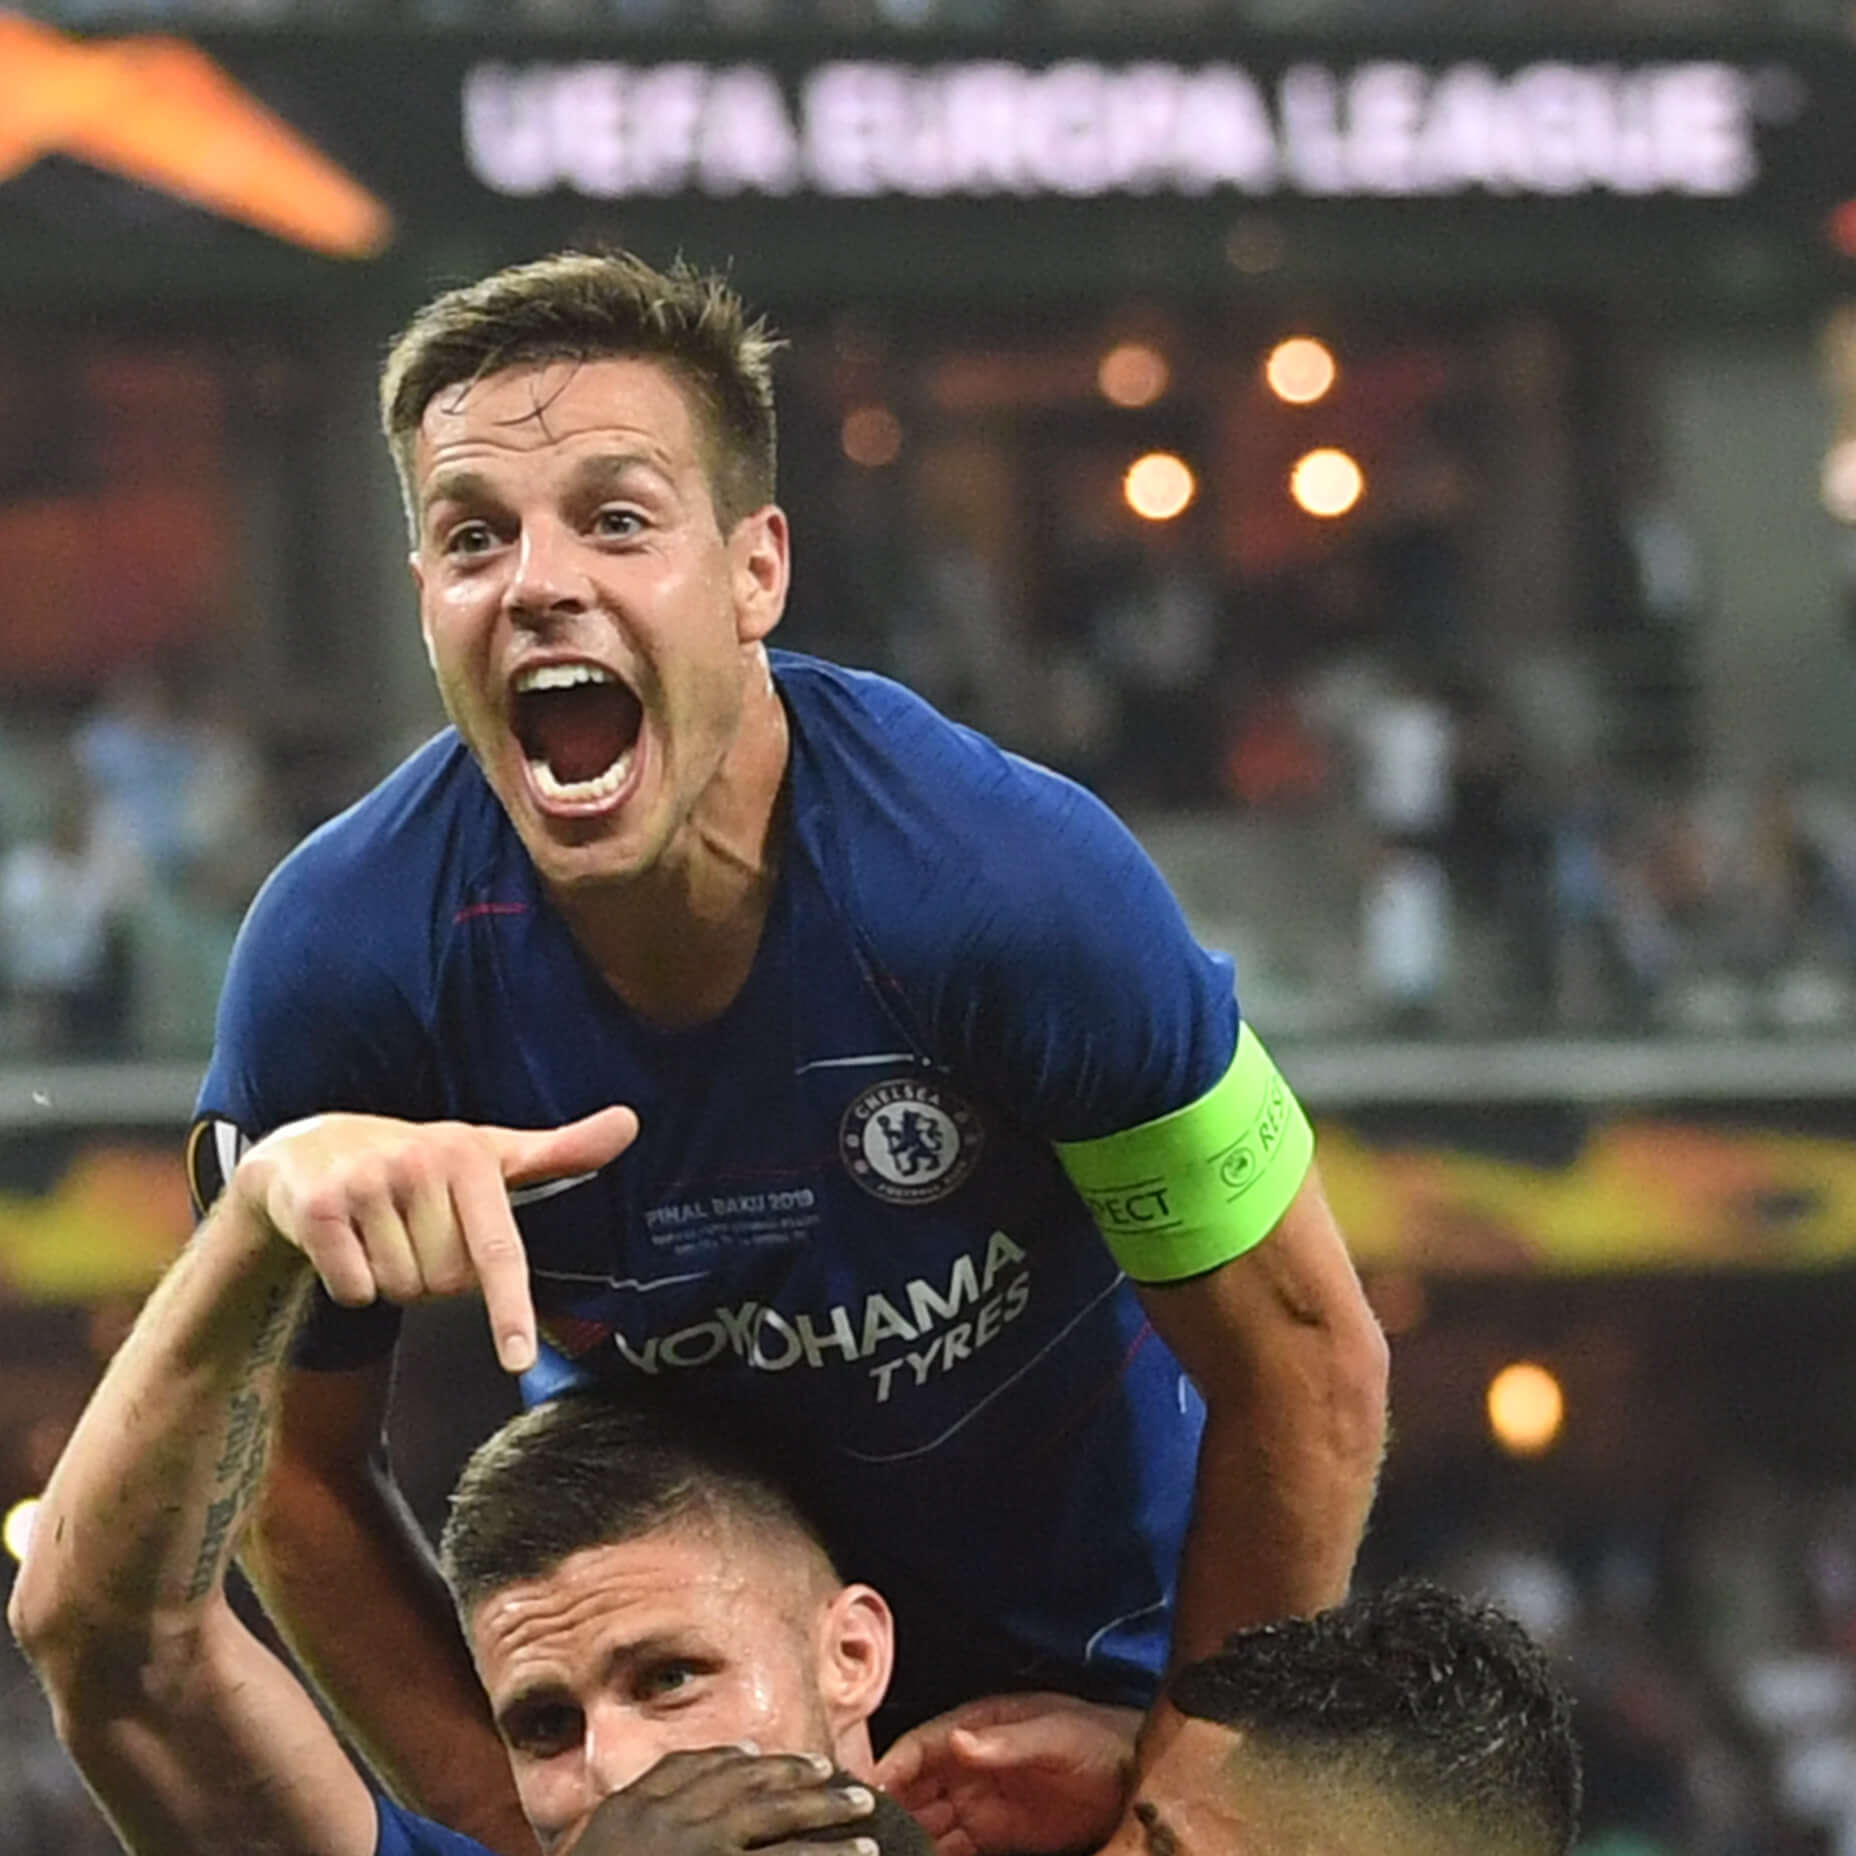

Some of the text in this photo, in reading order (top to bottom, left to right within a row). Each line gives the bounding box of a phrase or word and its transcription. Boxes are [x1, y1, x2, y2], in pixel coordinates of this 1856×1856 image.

[464, 60, 1754, 194] UEFA EUROPA LEAGUE
[854, 1084, 941, 1119] CHELSEA
[645, 1203, 708, 1228] FINAL
[614, 1230, 1027, 1374] YOKOHAMA
[869, 1270, 1031, 1402] TYRES
